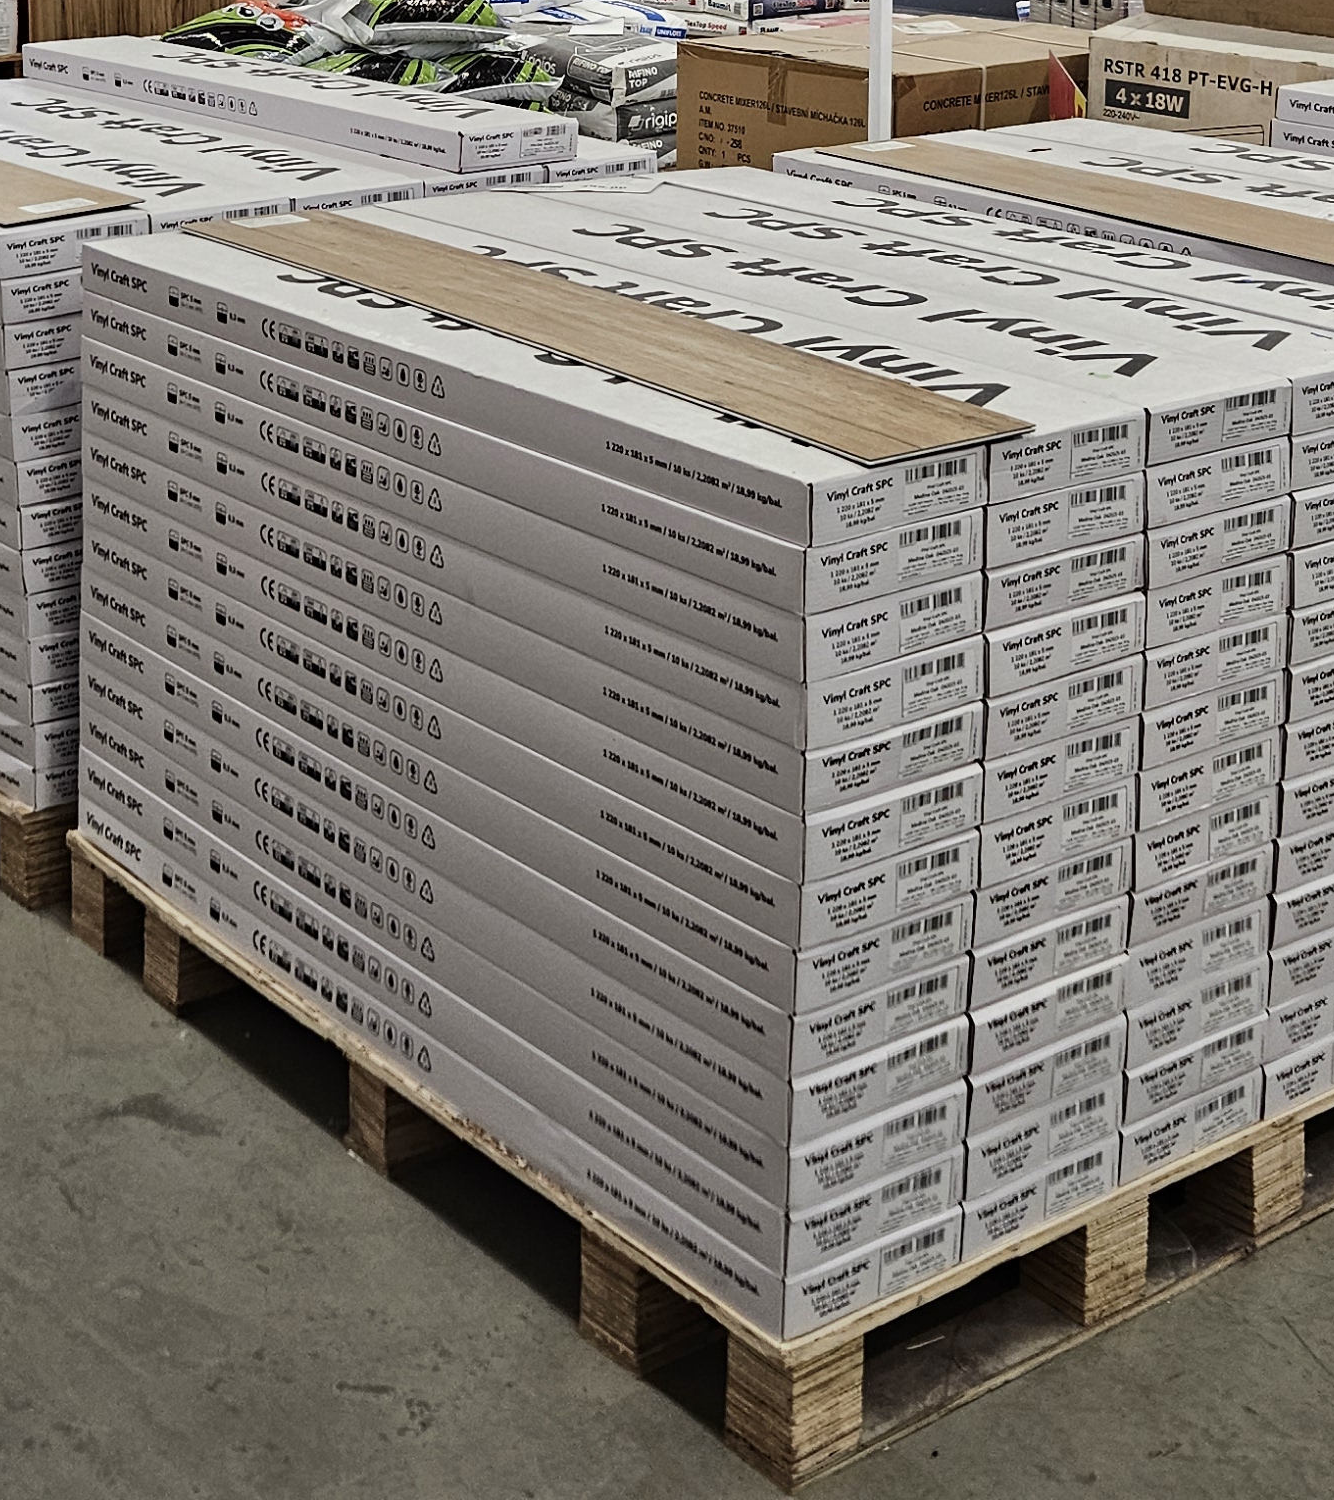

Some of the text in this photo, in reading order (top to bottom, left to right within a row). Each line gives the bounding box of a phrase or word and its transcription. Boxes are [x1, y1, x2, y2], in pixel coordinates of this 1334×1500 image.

[152, 46, 493, 118] Vinyl Craft SPC
[628, 66, 658, 79] RIFINO
[629, 78, 648, 88] TOP
[1104, 58, 1273, 97] RSTR 418 PT-EVG-H
[699, 91, 734, 105] CONCRETE
[775, 104, 809, 118] STAVEBNÍ
[810, 109, 849, 125] MÍCHAČKA
[1115, 89, 1185, 112] 4 x 18W
[1289, 99, 1312, 113] Vinyl
[10, 98, 342, 183] Vinyl Craft SPC
[469, 133, 485, 143] Vinyl
[501, 130, 514, 140] SPC
[699, 119, 713, 129] ITEM
[715, 121, 727, 131] NO.
[737, 153, 751, 164] PCS
[61, 158, 206, 197] Vinyl
[832, 196, 994, 228] SPC
[987, 225, 1192, 272] Craft
[90, 262, 148, 294] Vinyl Craft SPC
[702, 207, 1291, 352] Vinyl Craft SPC
[572, 222, 1159, 378] Vinyl Craft SPC
[1002, 439, 1062, 462] Vinyl Craft SPC
[827, 477, 894, 503] Vinyl Craft SPC
